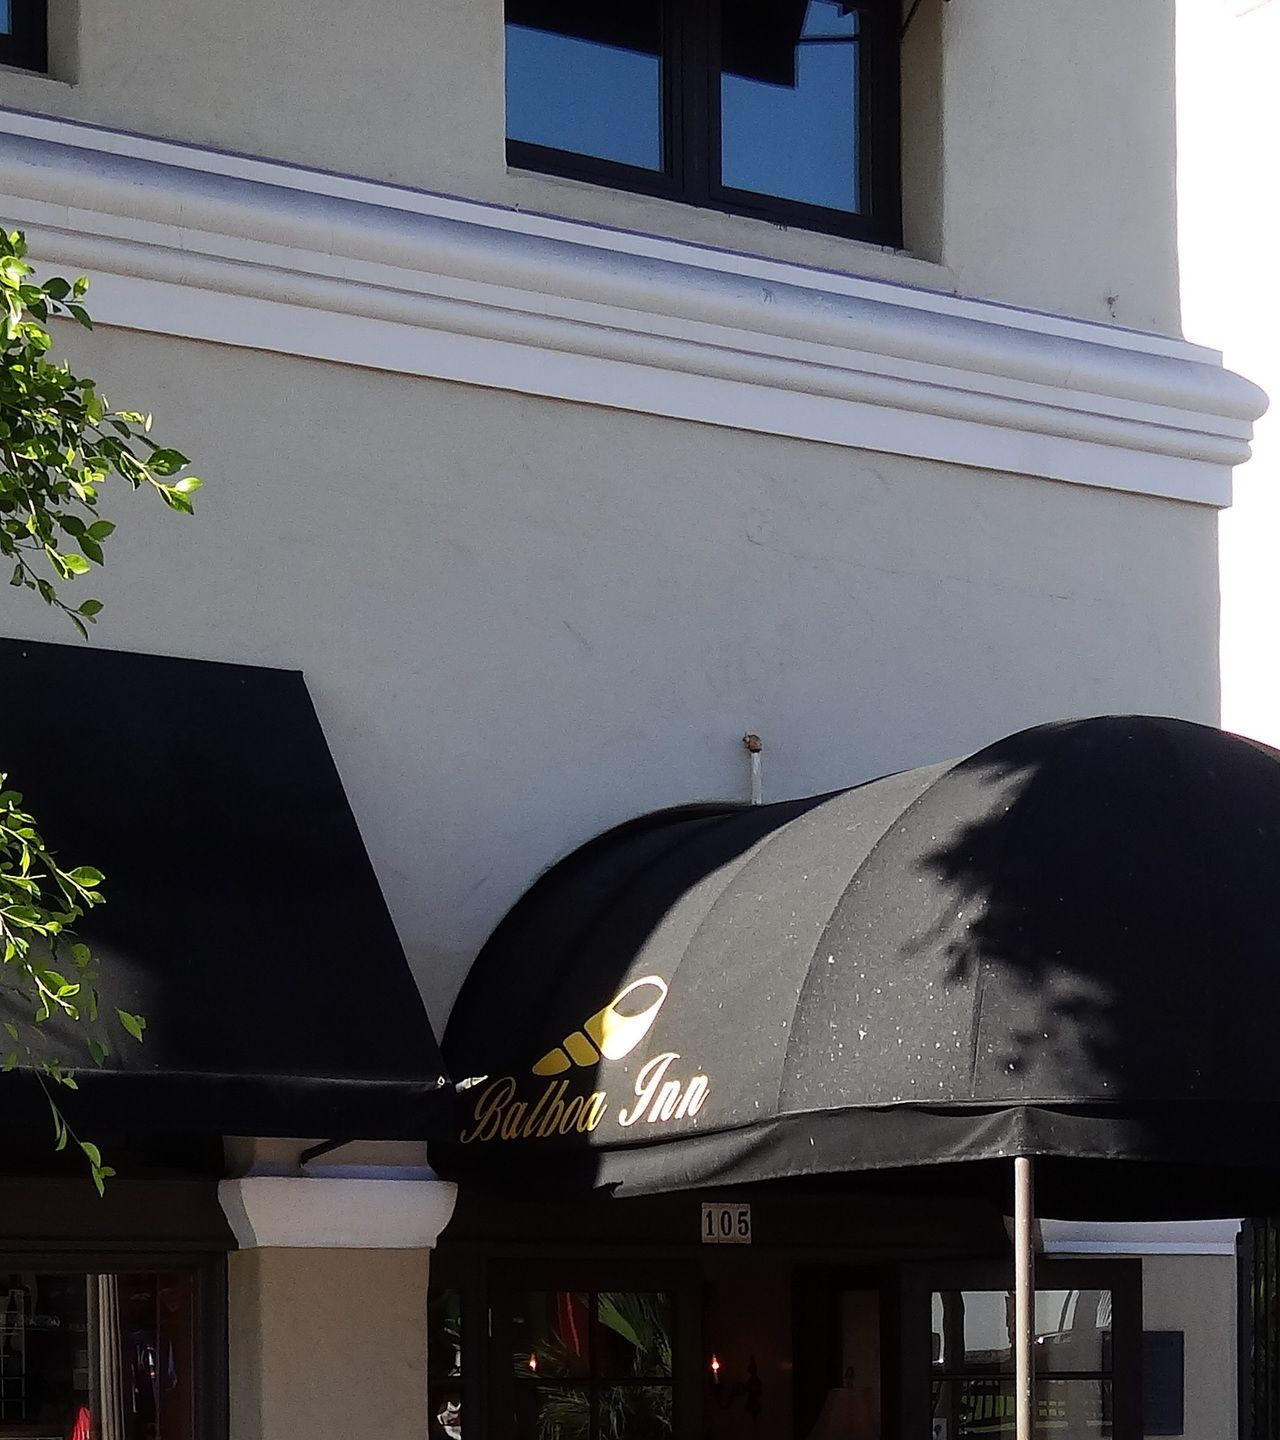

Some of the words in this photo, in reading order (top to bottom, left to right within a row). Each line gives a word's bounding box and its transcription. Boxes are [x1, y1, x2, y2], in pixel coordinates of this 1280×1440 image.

[460, 1076, 608, 1144] Balboa
[618, 1052, 710, 1127] Inn
[705, 1210, 750, 1238] 105
